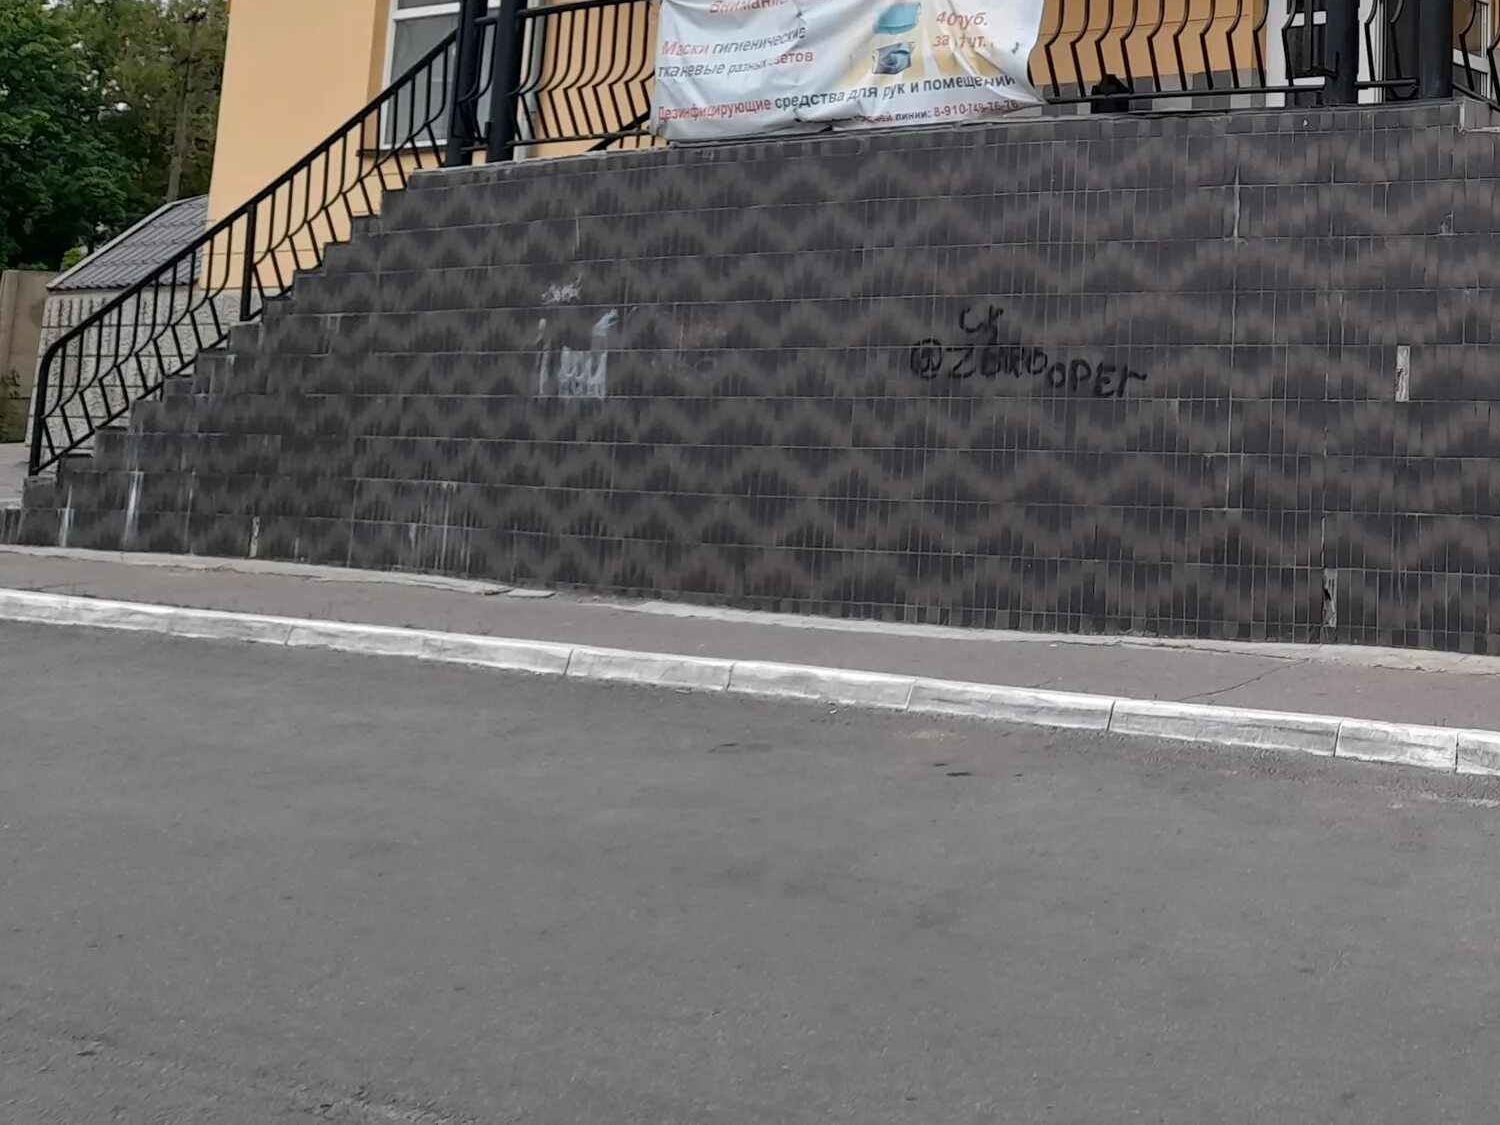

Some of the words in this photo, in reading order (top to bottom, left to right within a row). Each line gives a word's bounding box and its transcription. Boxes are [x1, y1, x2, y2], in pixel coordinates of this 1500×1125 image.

[662, 40, 709, 57] Маски
[712, 26, 806, 54] гигиенические
[932, 34, 950, 47] за
[658, 63, 726, 78] тканевые
[768, 51, 813, 67] ветов
[658, 97, 772, 121] Дезинфицирующие
[775, 90, 844, 111] средства
[846, 86, 877, 102] для
[883, 83, 905, 100] рук
[910, 82, 919, 94] и
[896, 110, 931, 122] линии:
